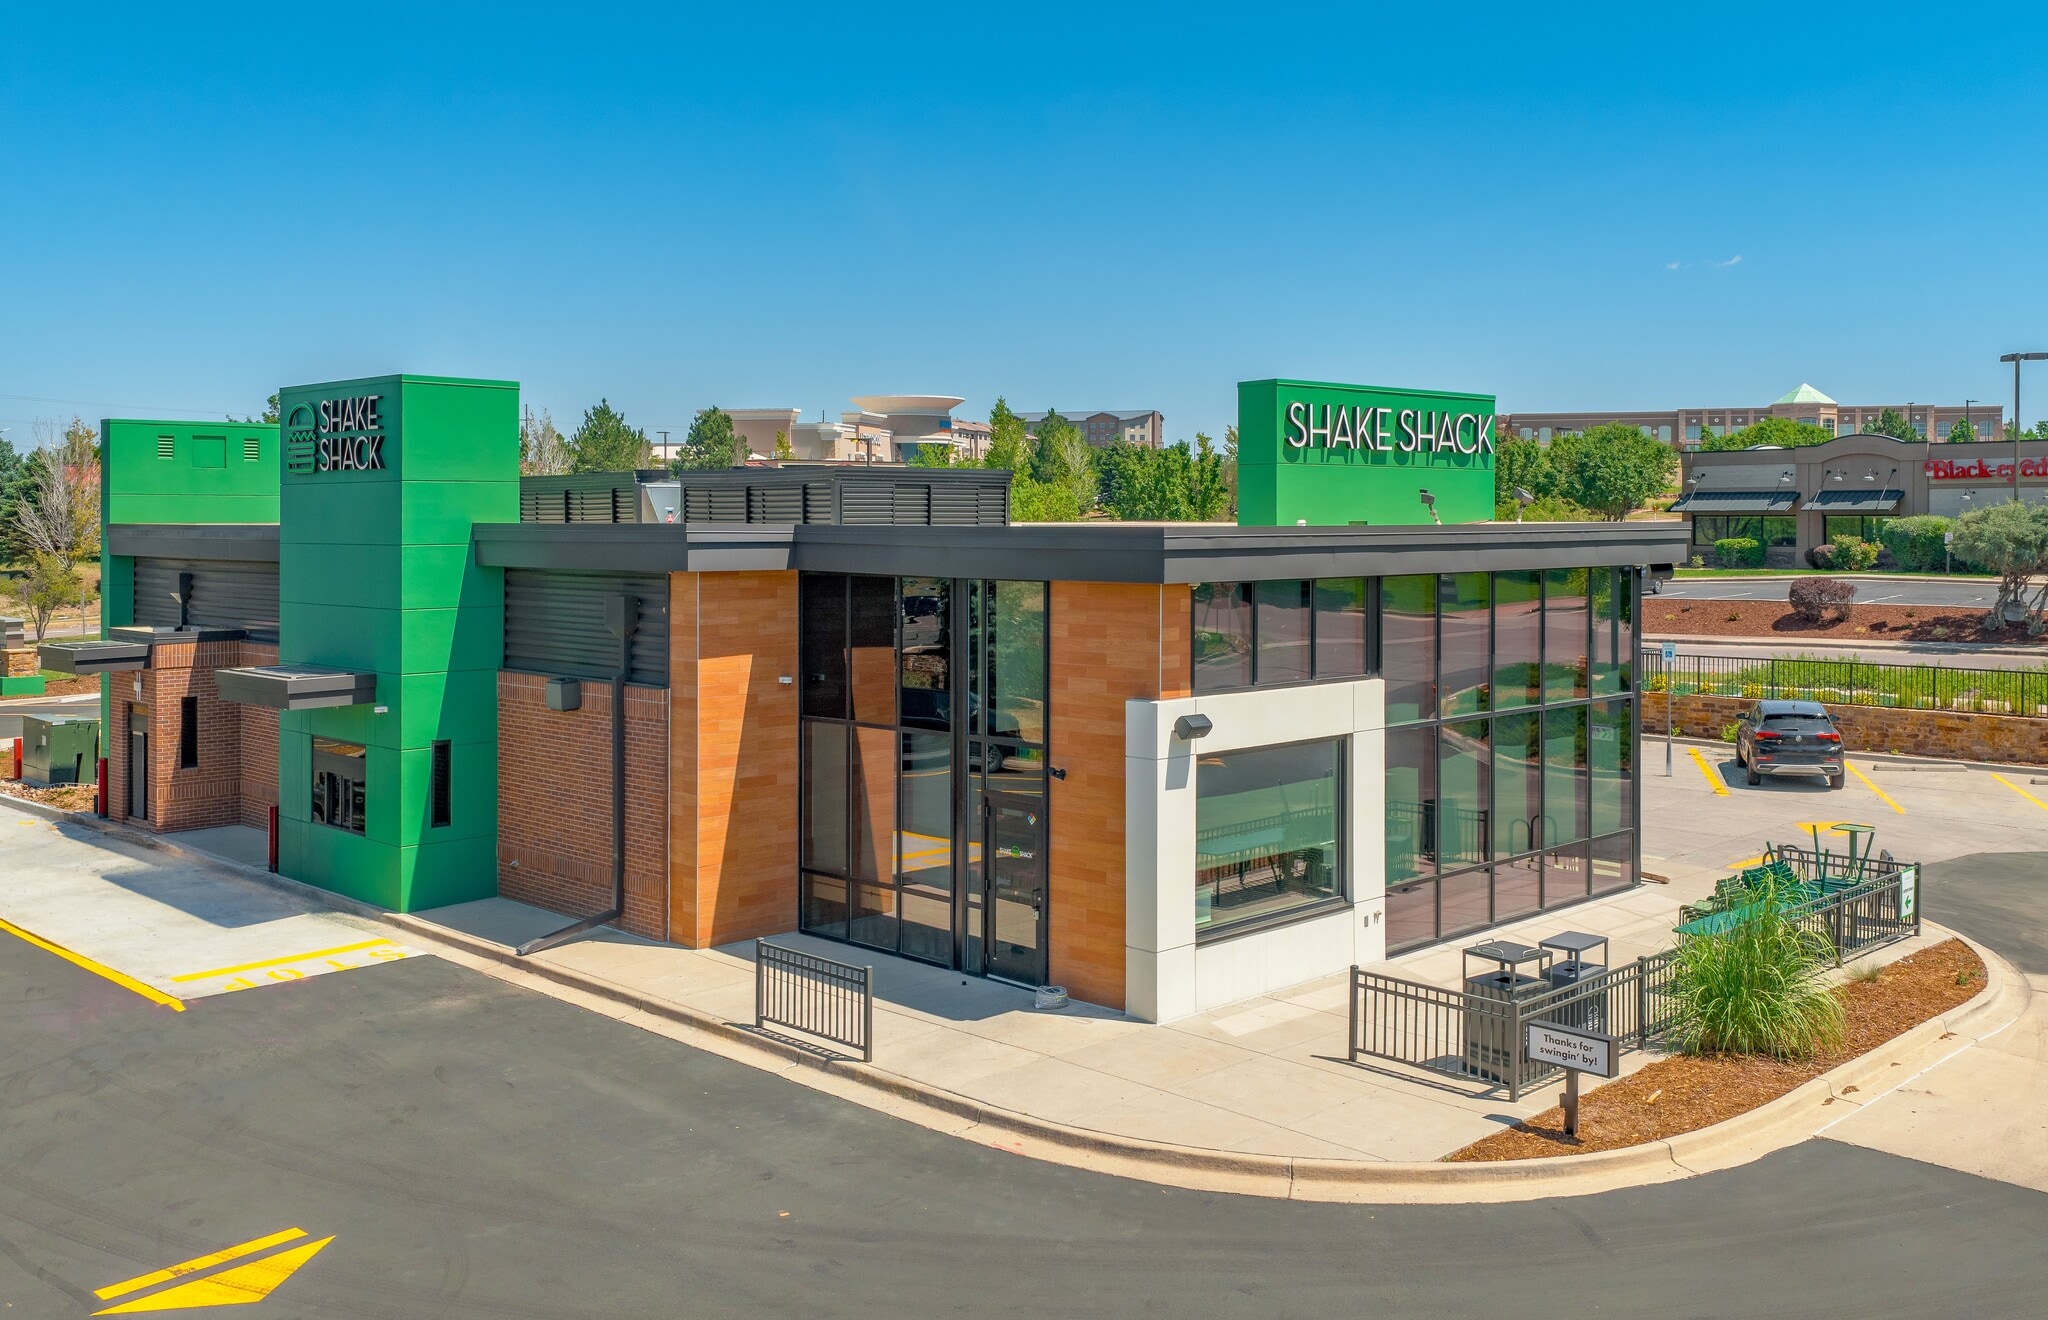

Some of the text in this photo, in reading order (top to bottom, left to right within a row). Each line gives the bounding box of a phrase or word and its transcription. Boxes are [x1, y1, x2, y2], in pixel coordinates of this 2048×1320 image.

[320, 395, 379, 433] SHAKE
[1285, 401, 1494, 454] SHAKE SHACK
[320, 435, 381, 472] SHACK
[1539, 1046, 1598, 1067] swingin' by!
[1543, 1033, 1594, 1053] Thanks for
